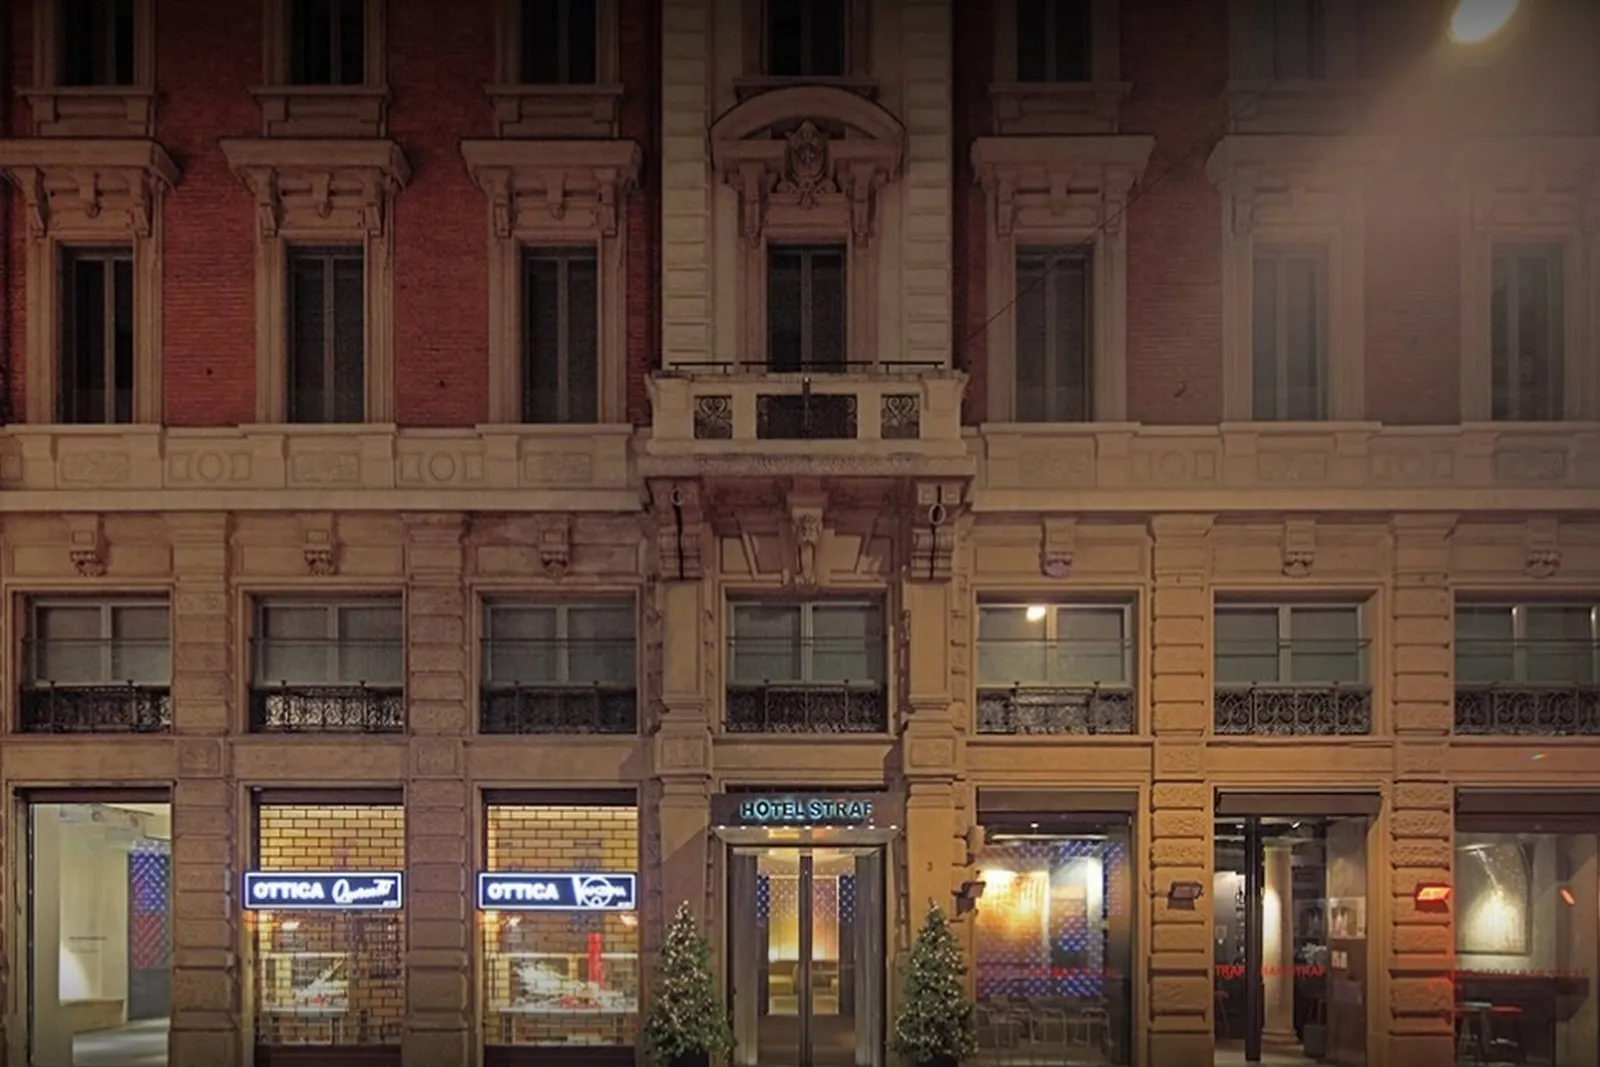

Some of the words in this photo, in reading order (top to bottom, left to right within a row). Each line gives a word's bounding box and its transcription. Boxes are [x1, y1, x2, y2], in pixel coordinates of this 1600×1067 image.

[741, 799, 805, 819] HOTEL
[808, 799, 873, 819] STRAF
[253, 881, 325, 899] OTTICA
[487, 882, 560, 900] OTTICA
